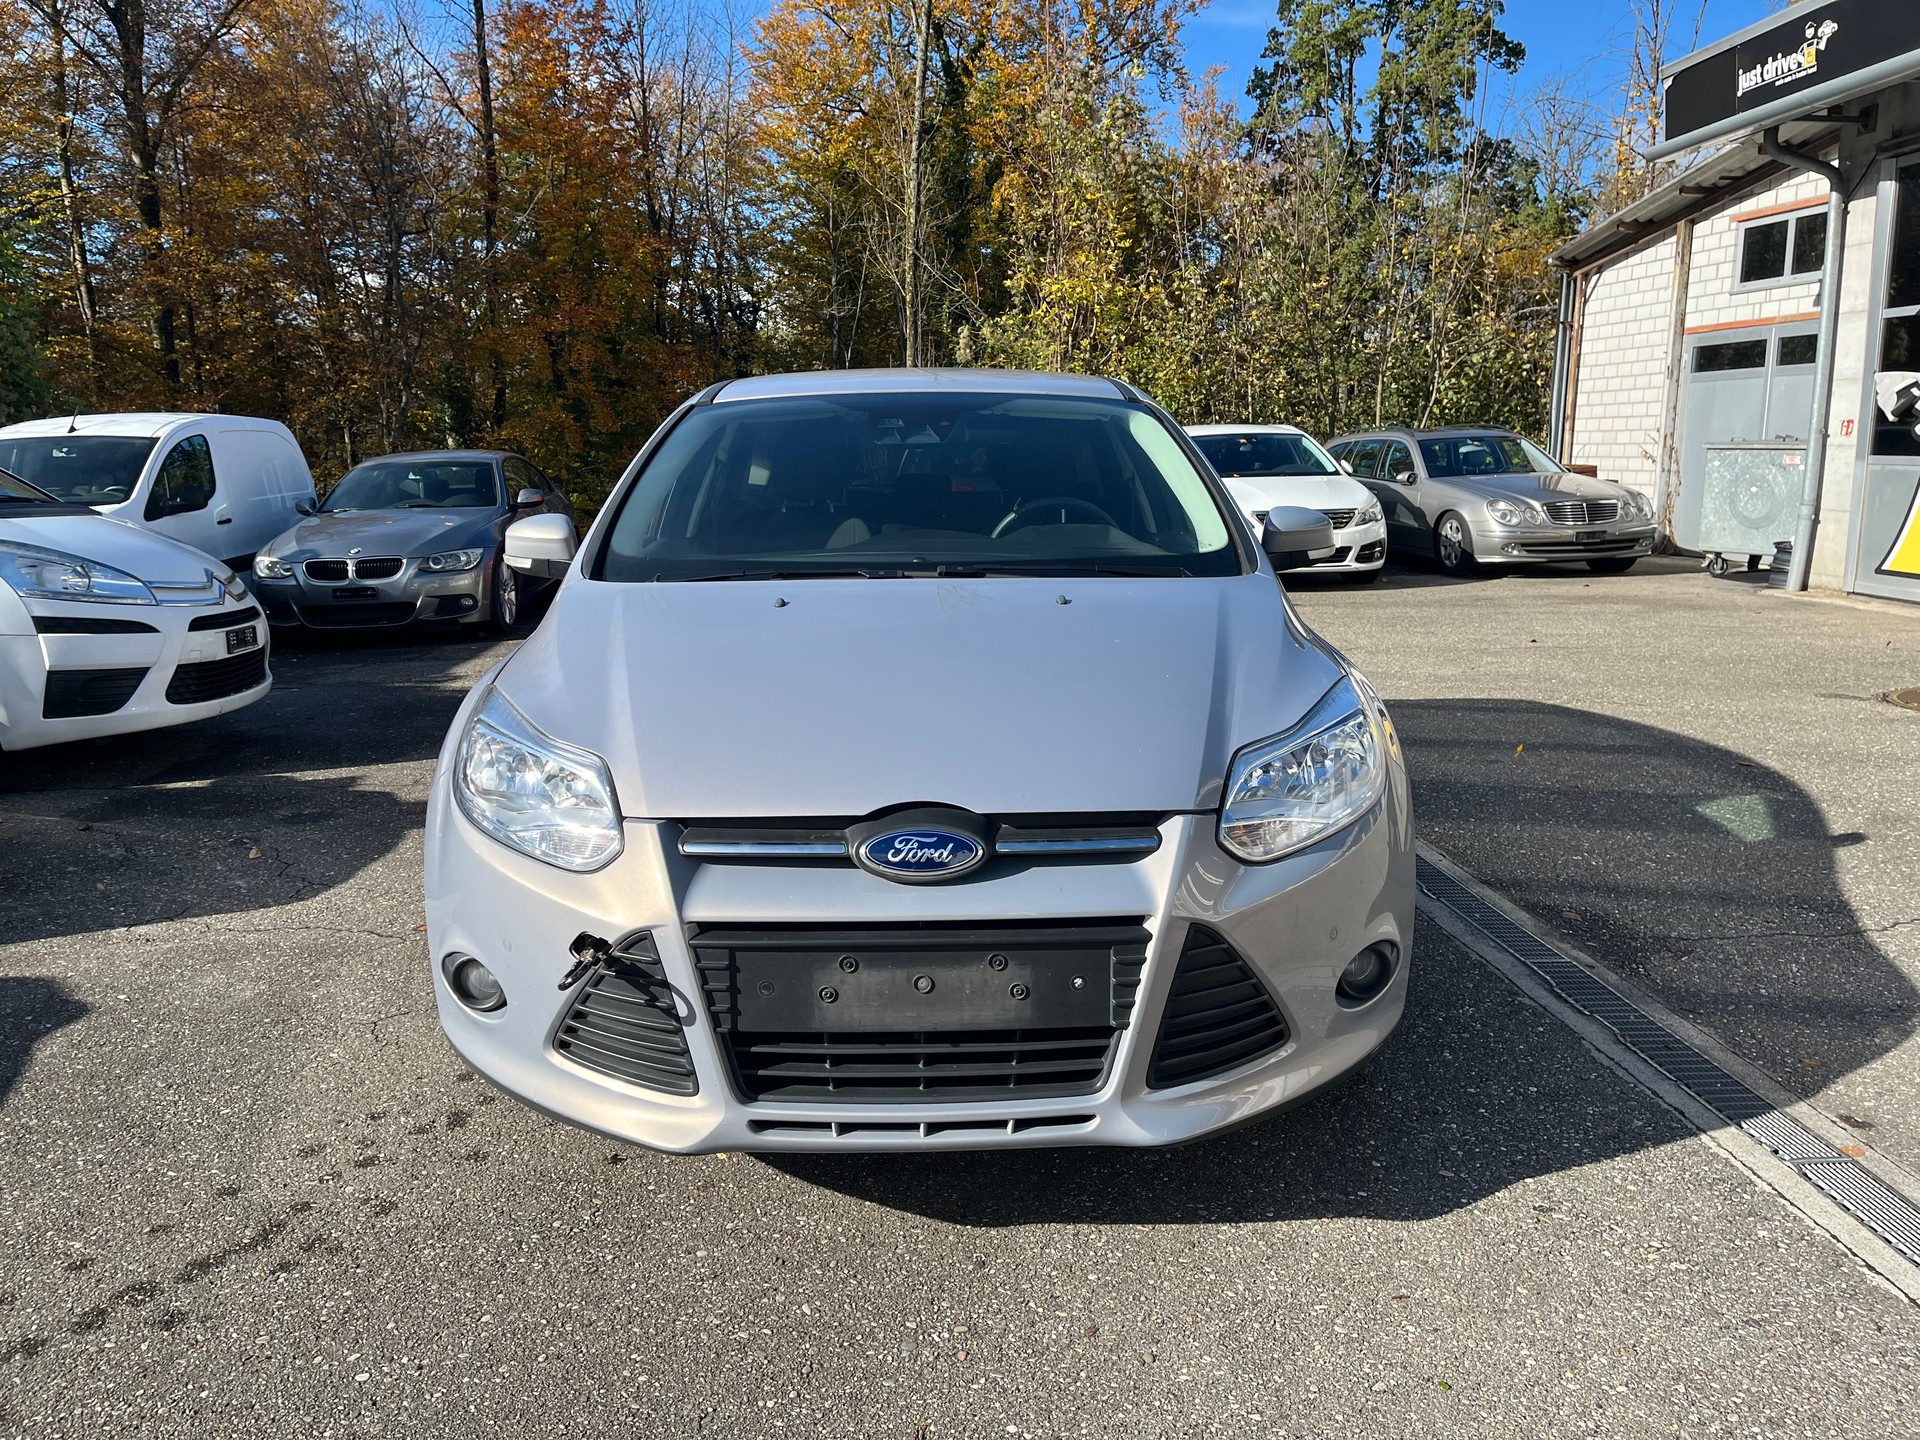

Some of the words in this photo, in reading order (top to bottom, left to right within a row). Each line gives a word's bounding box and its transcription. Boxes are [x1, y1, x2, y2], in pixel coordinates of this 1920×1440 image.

[1737, 63, 1762, 97] just
[1763, 52, 1799, 81] drive
[887, 835, 954, 863] Ford
